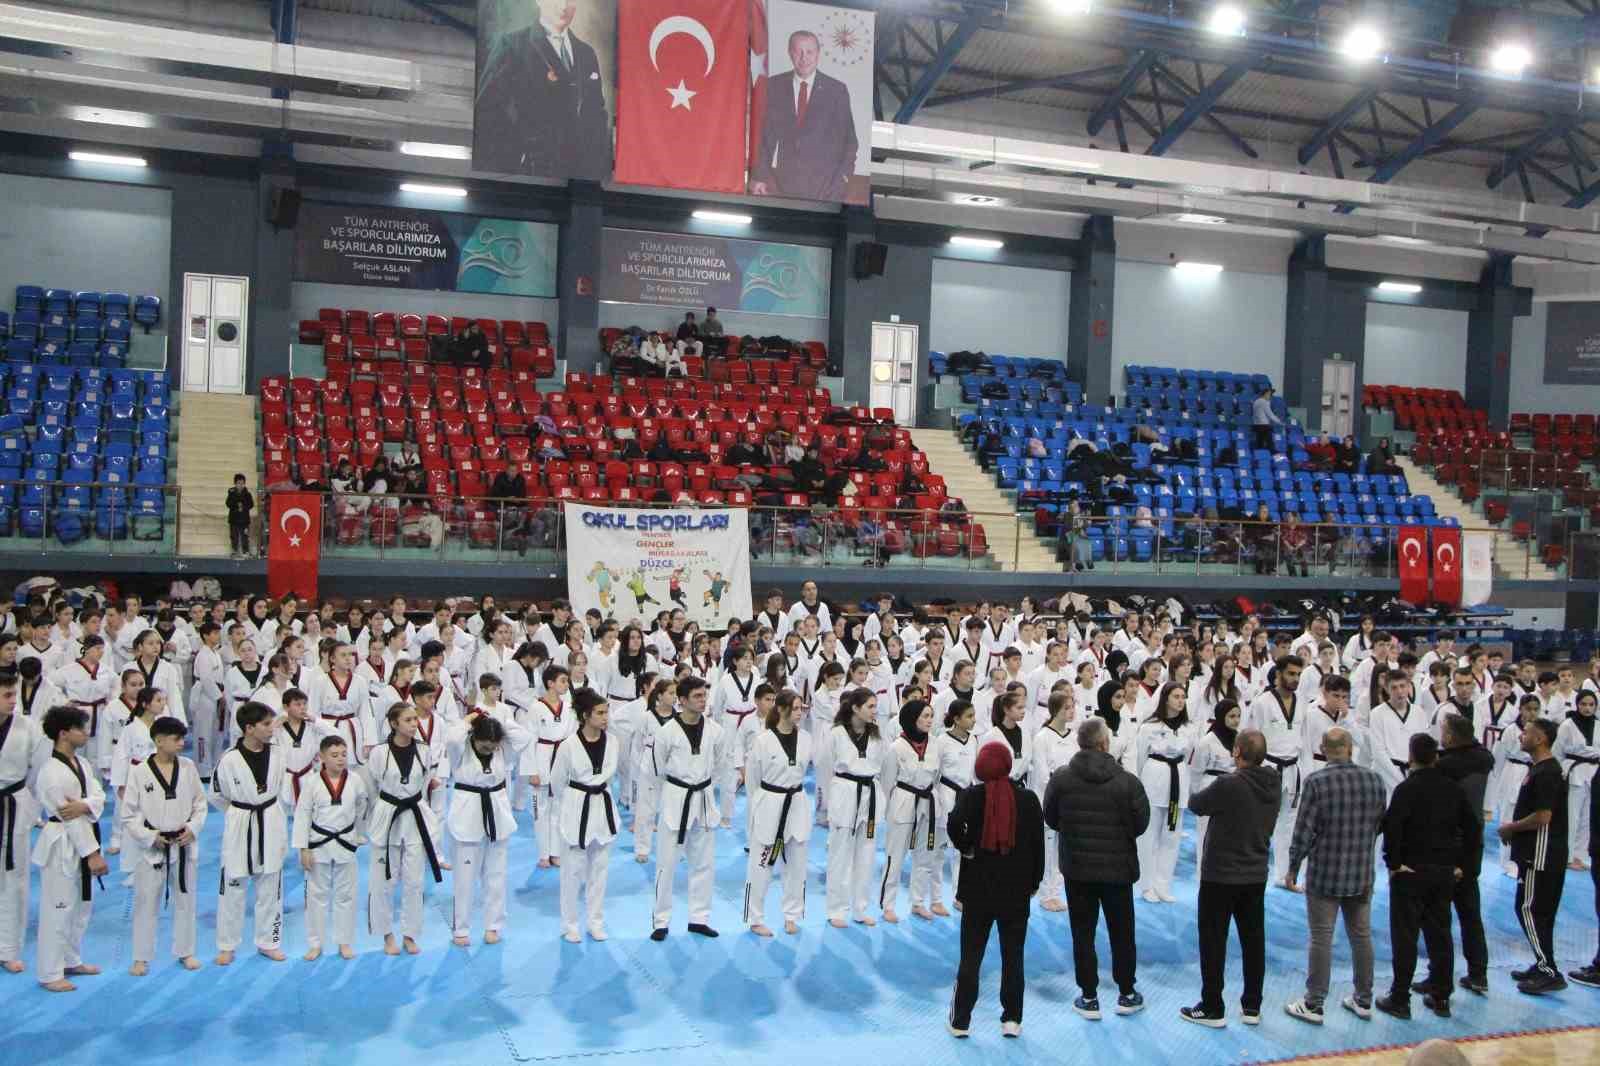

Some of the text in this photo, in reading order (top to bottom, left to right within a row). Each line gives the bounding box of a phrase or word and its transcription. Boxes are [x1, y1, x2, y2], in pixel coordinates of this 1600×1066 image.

[344, 216, 429, 233] TÜM ANTRENÖR
[330, 226, 441, 244] VE SPORCULARIMIZA
[323, 239, 447, 259] BAŞARILAR DİLİYORUM
[642, 251, 726, 268] SPORCULARIMIZA
[621, 263, 731, 281] BAŞARILAR DİLİYORUM
[582, 511, 730, 532] OKUL SPORLARI
[640, 558, 674, 568] DÜZCE
